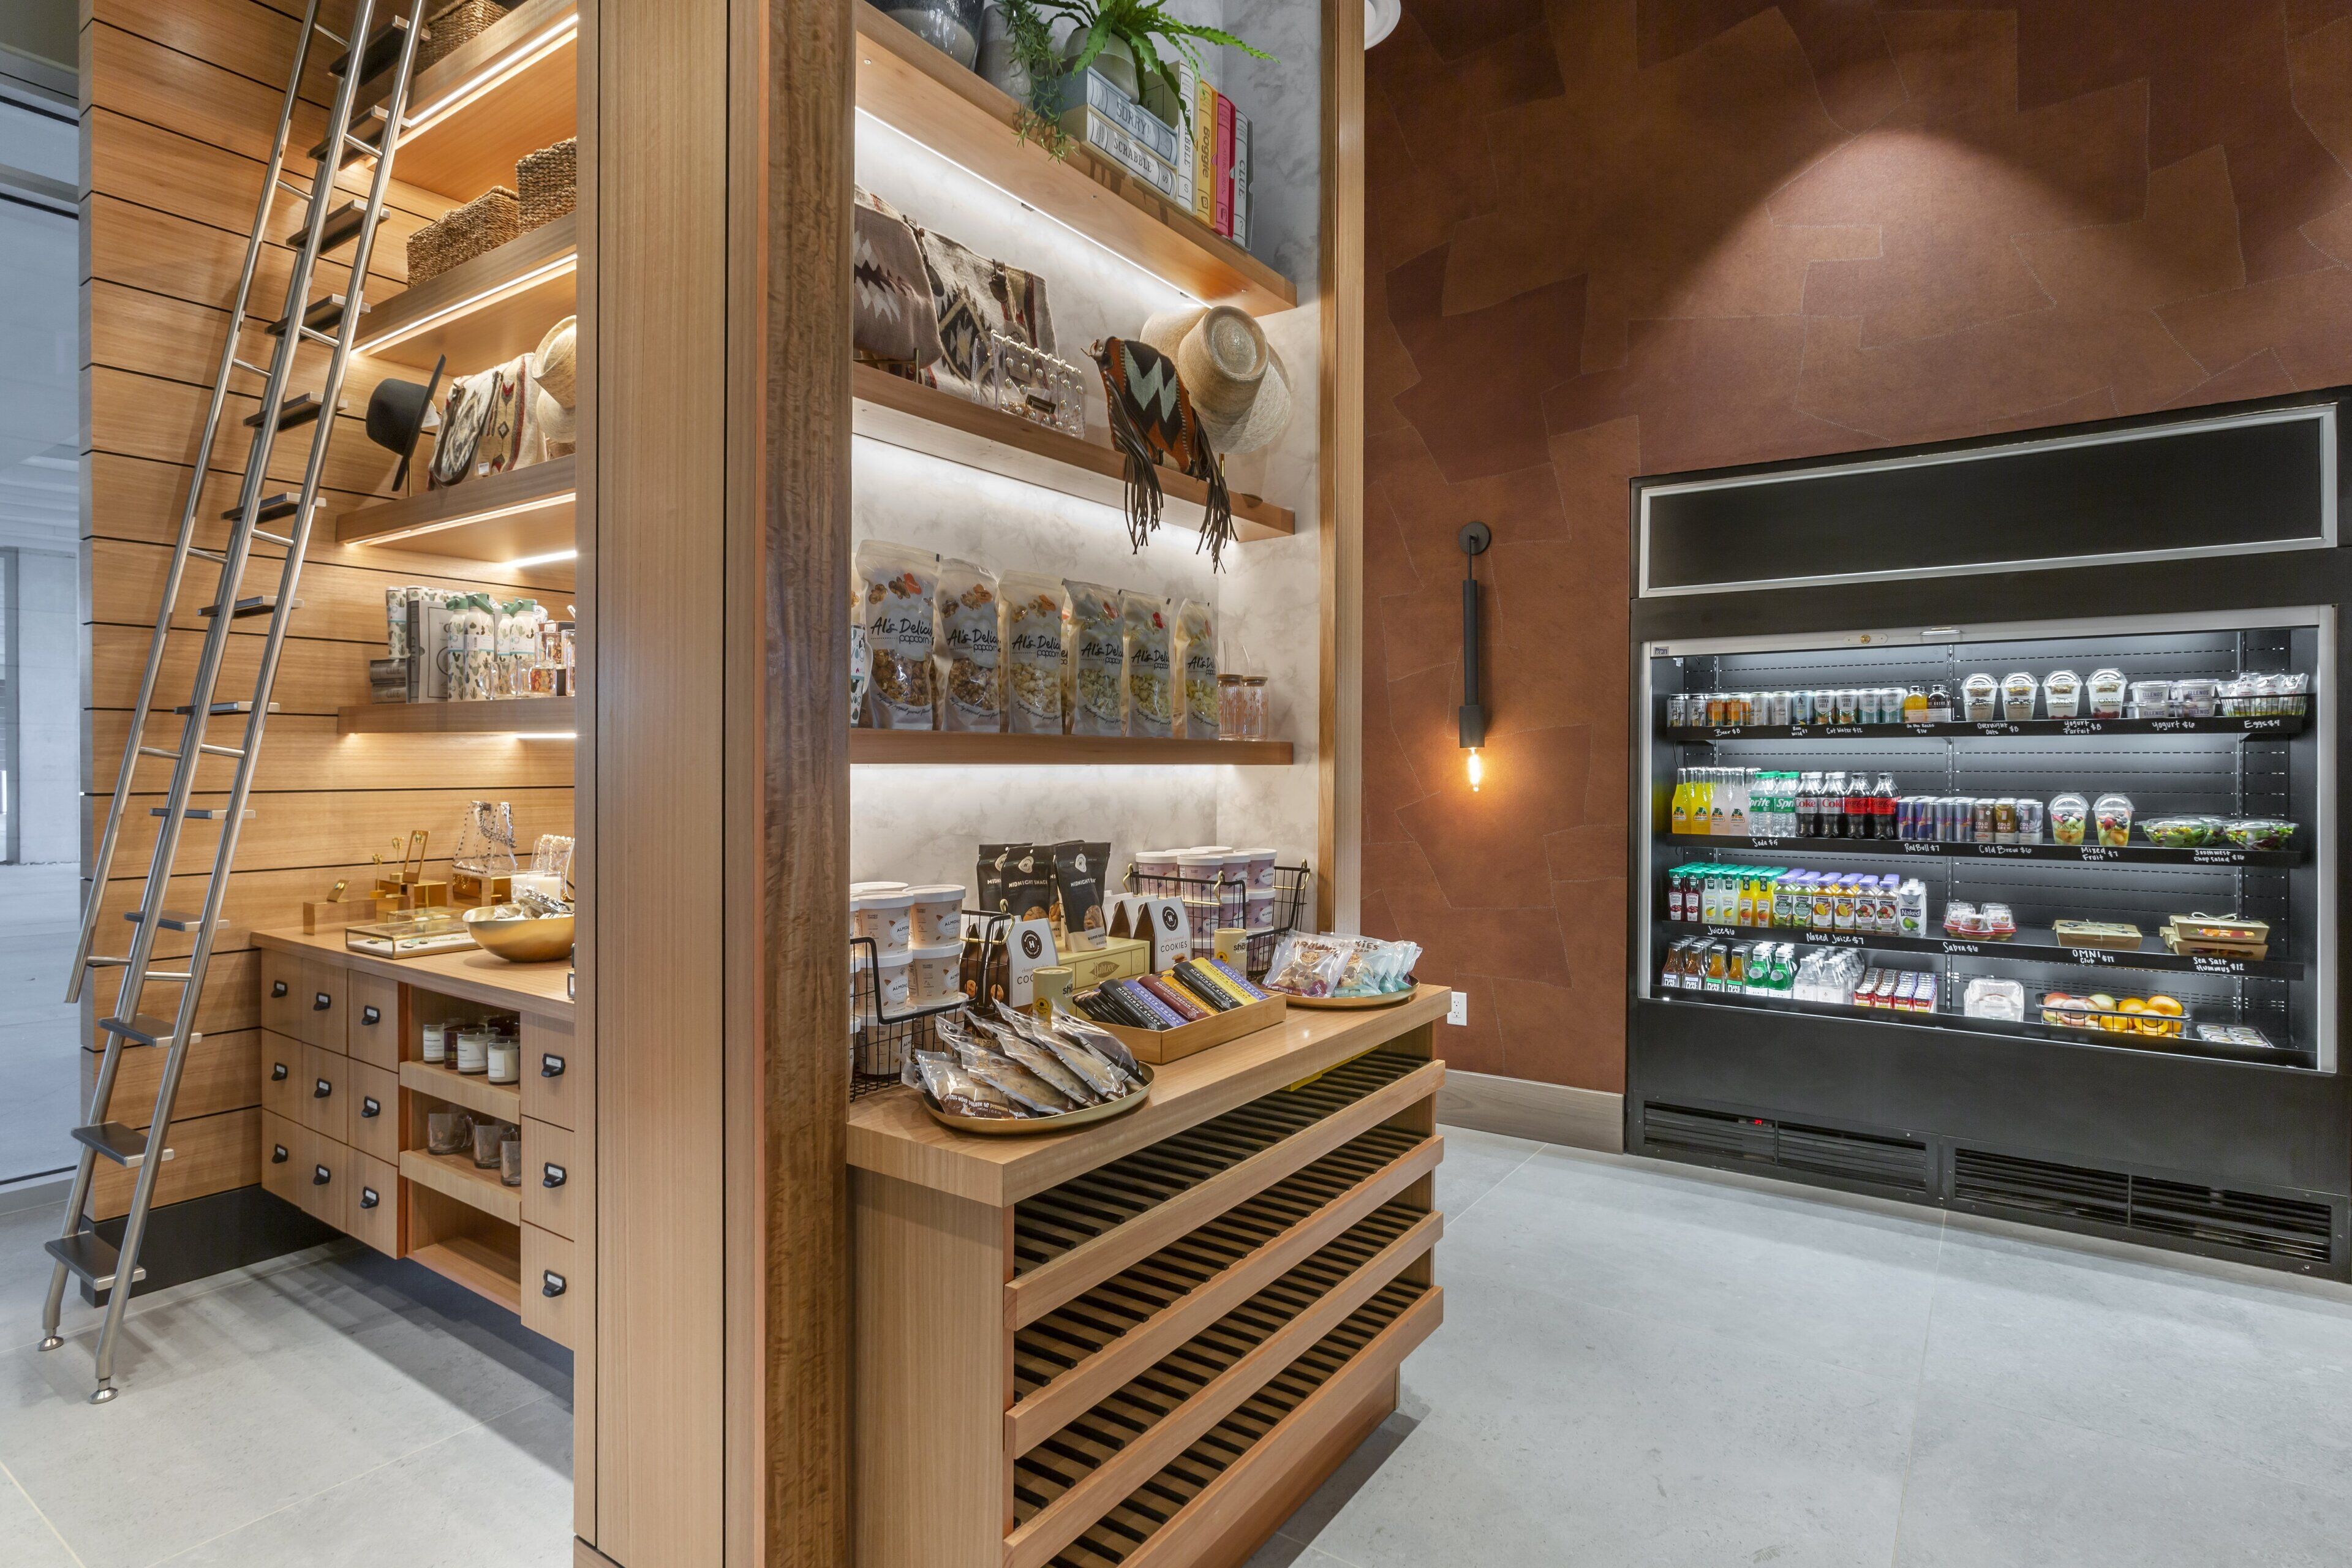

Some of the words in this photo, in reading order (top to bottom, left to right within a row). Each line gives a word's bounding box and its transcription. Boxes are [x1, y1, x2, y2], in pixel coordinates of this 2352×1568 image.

[1117, 101, 1151, 138] SORRY!
[1114, 138, 1152, 173] SCRABBLE
[1201, 126, 1210, 178] Boggle
[870, 616, 898, 636] Al's
[899, 635, 930, 644] popcorn
[947, 628, 971, 646] Al's
[1012, 634, 1036, 650] Al's
[973, 644, 998, 654] popcorn
[1080, 642, 1104, 658] Al's
[1131, 649, 1153, 663] Al's
[1188, 656, 1206, 670] Al's
[2152, 720, 2179, 731] Yogurt
[2244, 720, 2267, 728] Eggs
[1776, 798, 1795, 809] Spri
[1795, 799, 1816, 807] Coke
[1822, 799, 1843, 807] Cok
[1752, 839, 1767, 847] Soda
[1979, 845, 1996, 854] Cold
[1070, 878, 1091, 887] MIDNIGHT
[1708, 925, 1725, 935] Juice
[1807, 933, 1829, 943] Naked
[1831, 934, 1851, 944] Juice
[1160, 941, 1188, 952] COOKIES
[1943, 942, 1966, 953] Sabra
[2072, 949, 2101, 958] OMNI
[1093, 961, 1115, 980] Yahtzee
[2196, 965, 2231, 973] Hummus
[1191, 968, 1215, 989] MIDNIGHT
[1216, 989, 1233, 1003] SNACK
[1221, 966, 1242, 982] COOKIE
[1243, 982, 1262, 998] DOUGH
[1156, 982, 1177, 997] BOURBON
[1177, 996, 1191, 1008] PECAN
[1118, 987, 1144, 1009] MIDNIGHT
[1144, 1011, 1161, 1025] SNACK
[1121, 986, 1167, 1025] HAMMOND'S
[1136, 987, 1158, 1005] COOKIE
[1161, 1007, 1180, 1023] DOUGH
